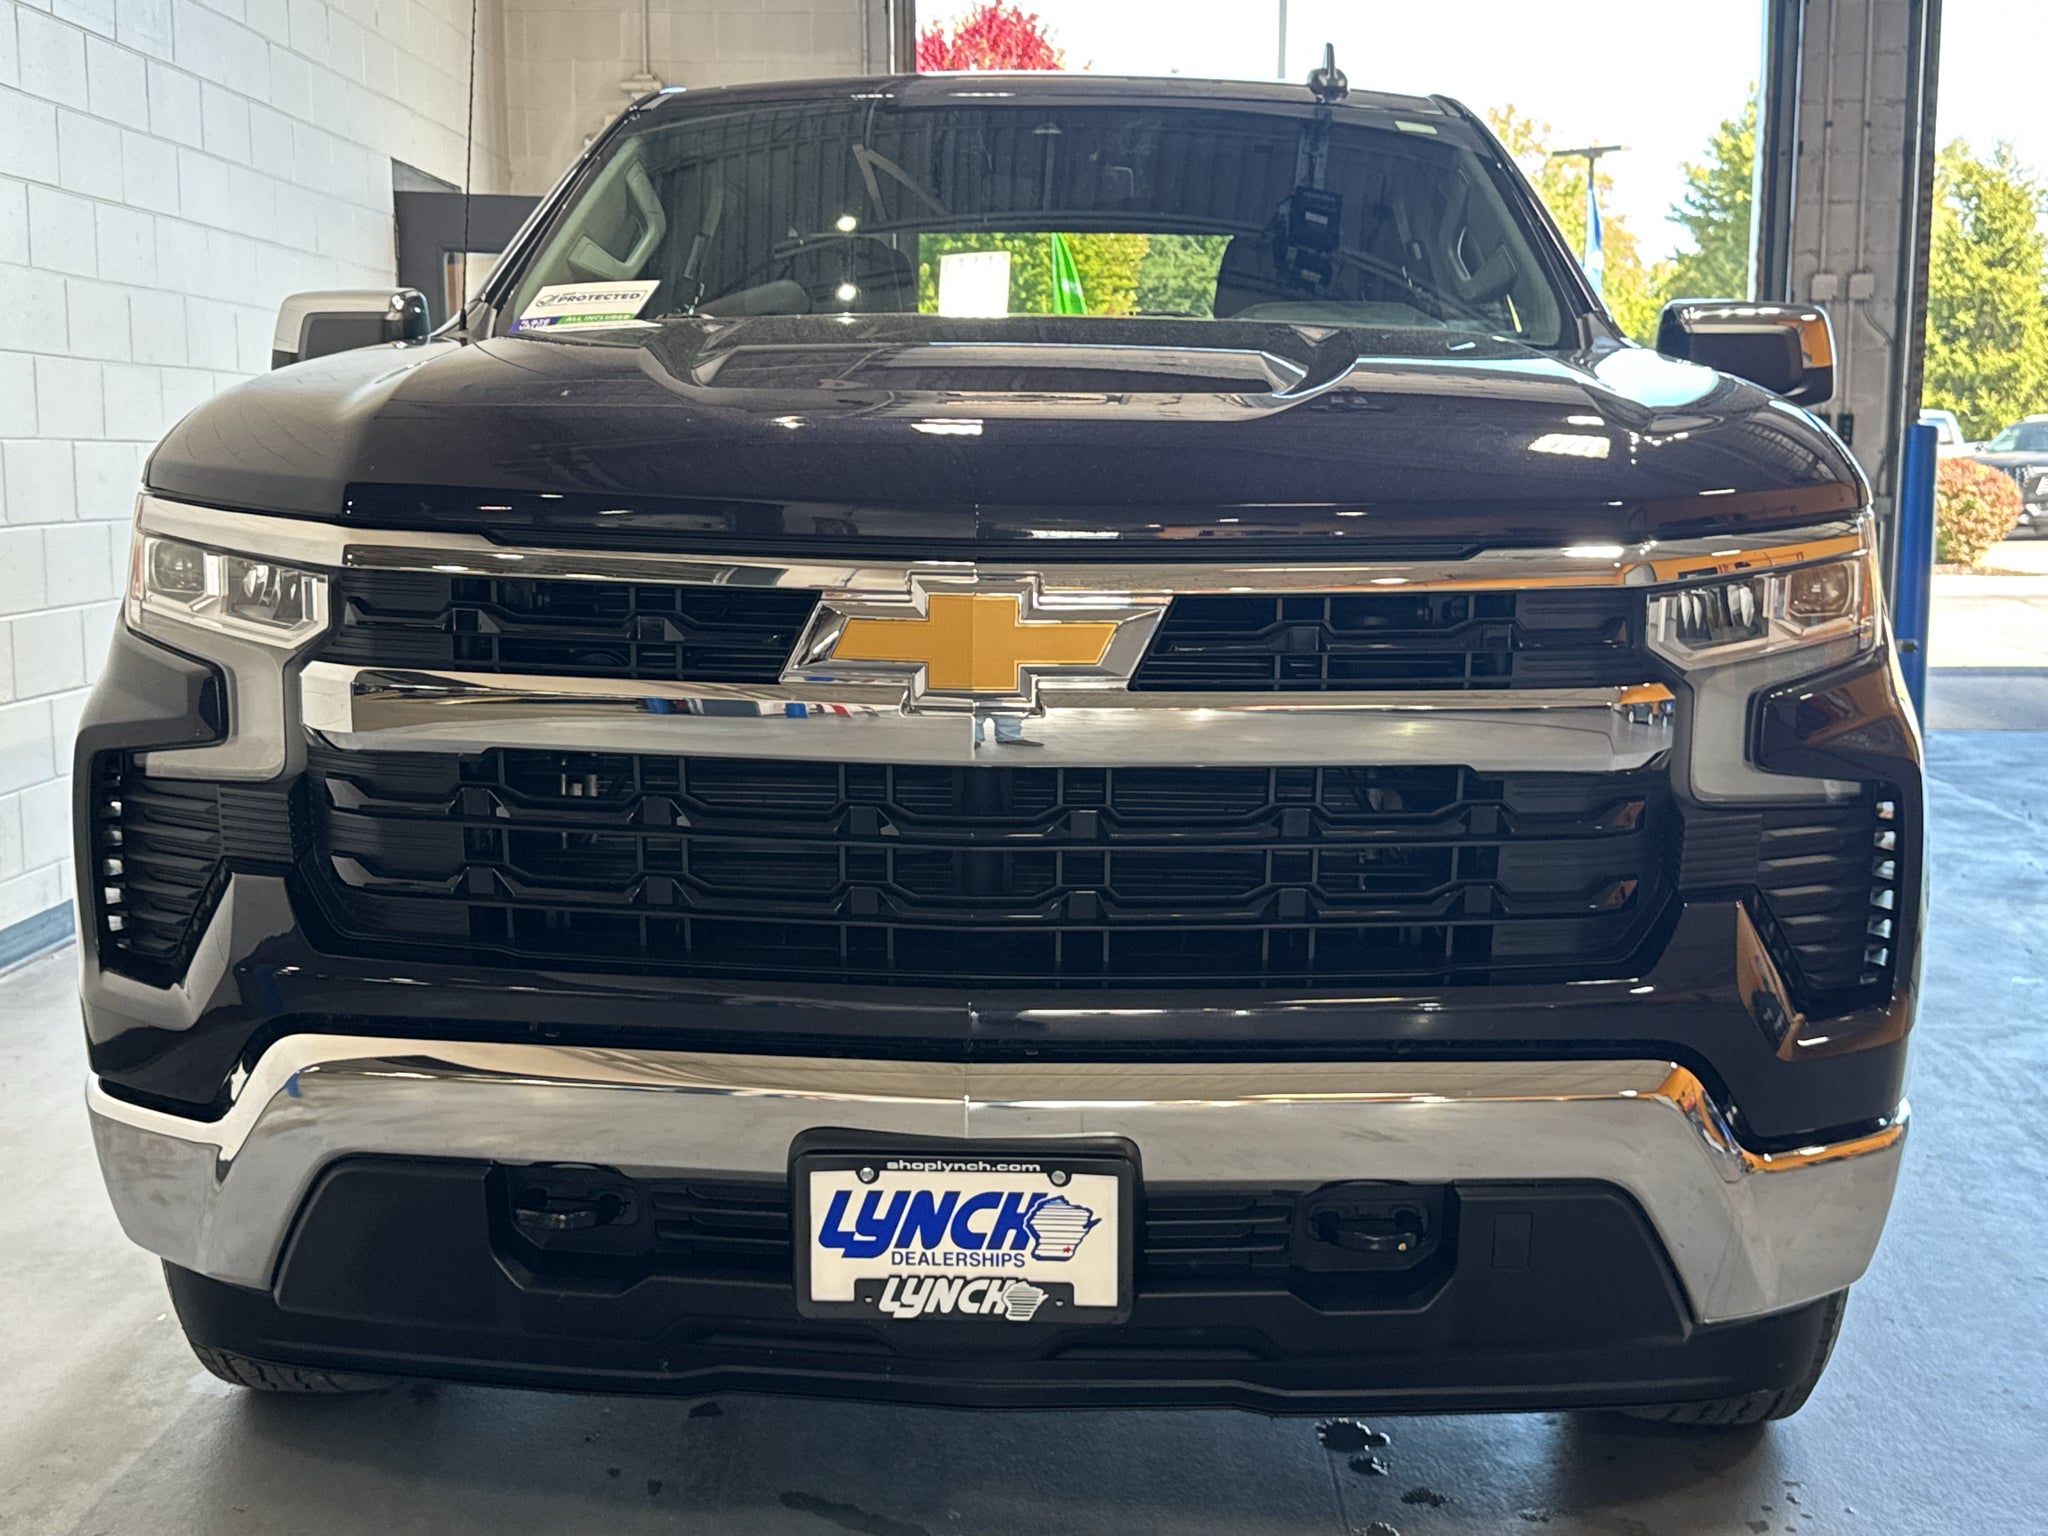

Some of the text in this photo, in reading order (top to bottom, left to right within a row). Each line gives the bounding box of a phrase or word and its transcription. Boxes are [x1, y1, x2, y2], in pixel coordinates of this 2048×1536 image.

[557, 292, 641, 303] PROTECTED
[886, 1159, 1041, 1173] shoplynch.com
[818, 1190, 1049, 1259] LYNCH
[891, 1251, 1026, 1268] DEALERSHIPS
[878, 1276, 1018, 1319] LYNCH
